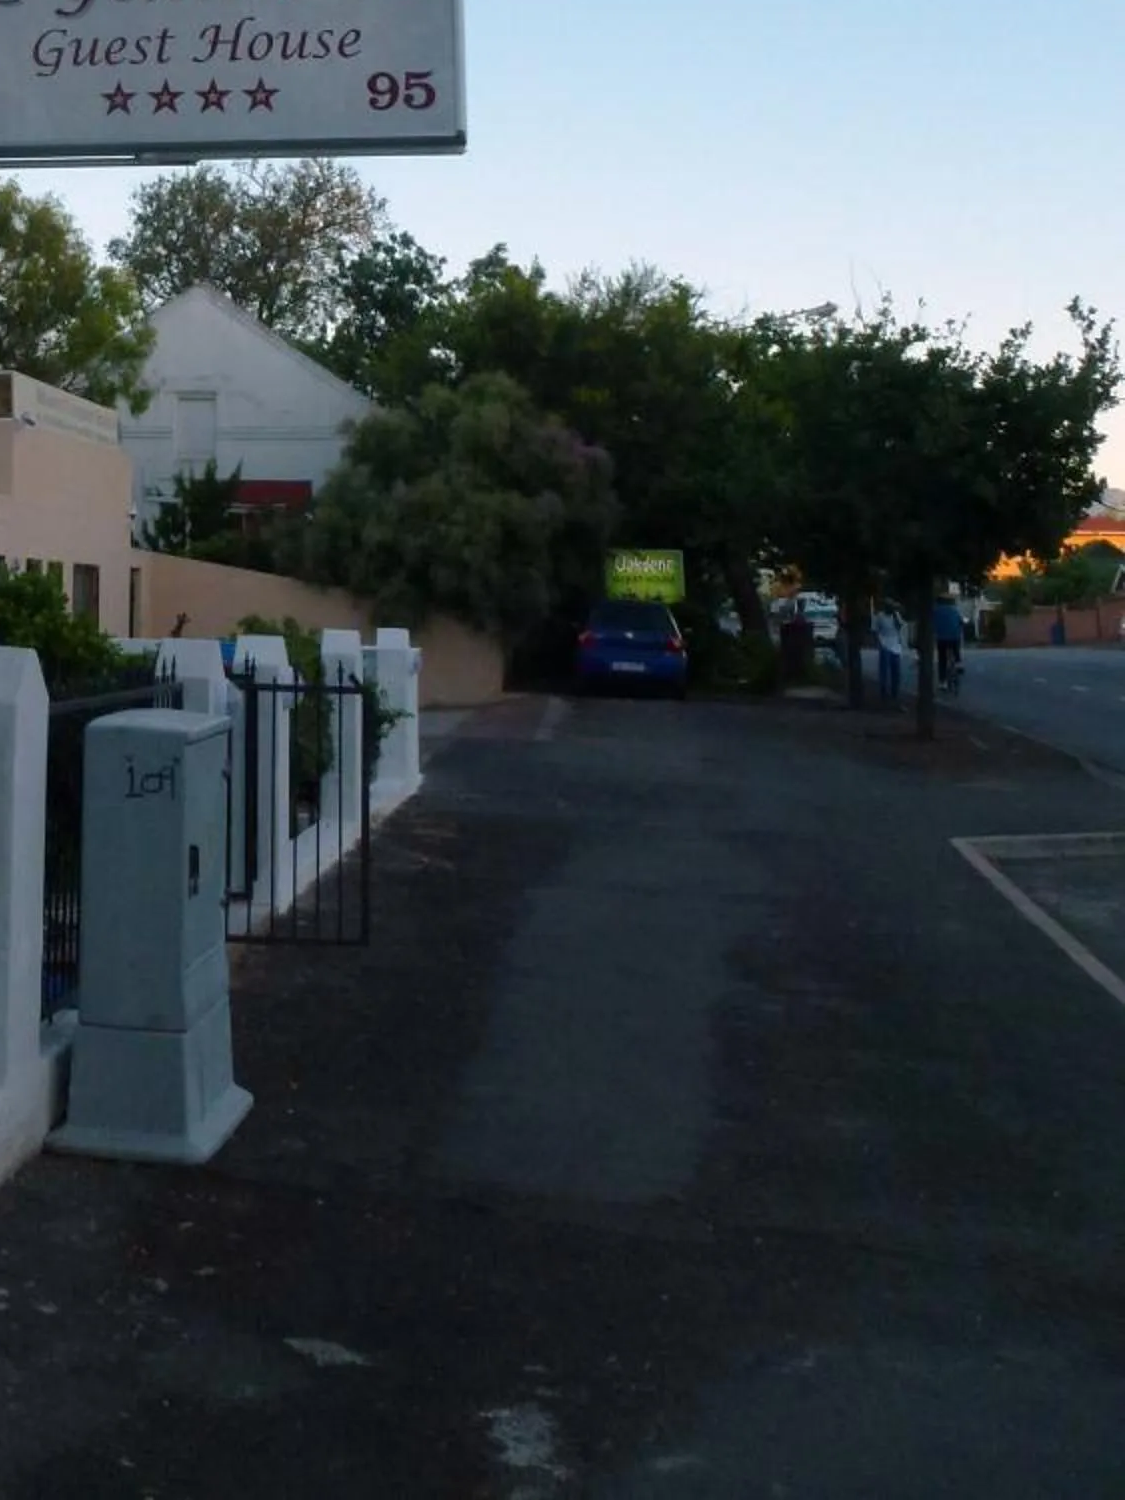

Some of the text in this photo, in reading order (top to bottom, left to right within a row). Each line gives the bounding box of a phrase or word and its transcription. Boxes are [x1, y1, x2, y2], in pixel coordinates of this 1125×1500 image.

[32, 17, 362, 77] Guest House
[366, 69, 436, 111] 95
